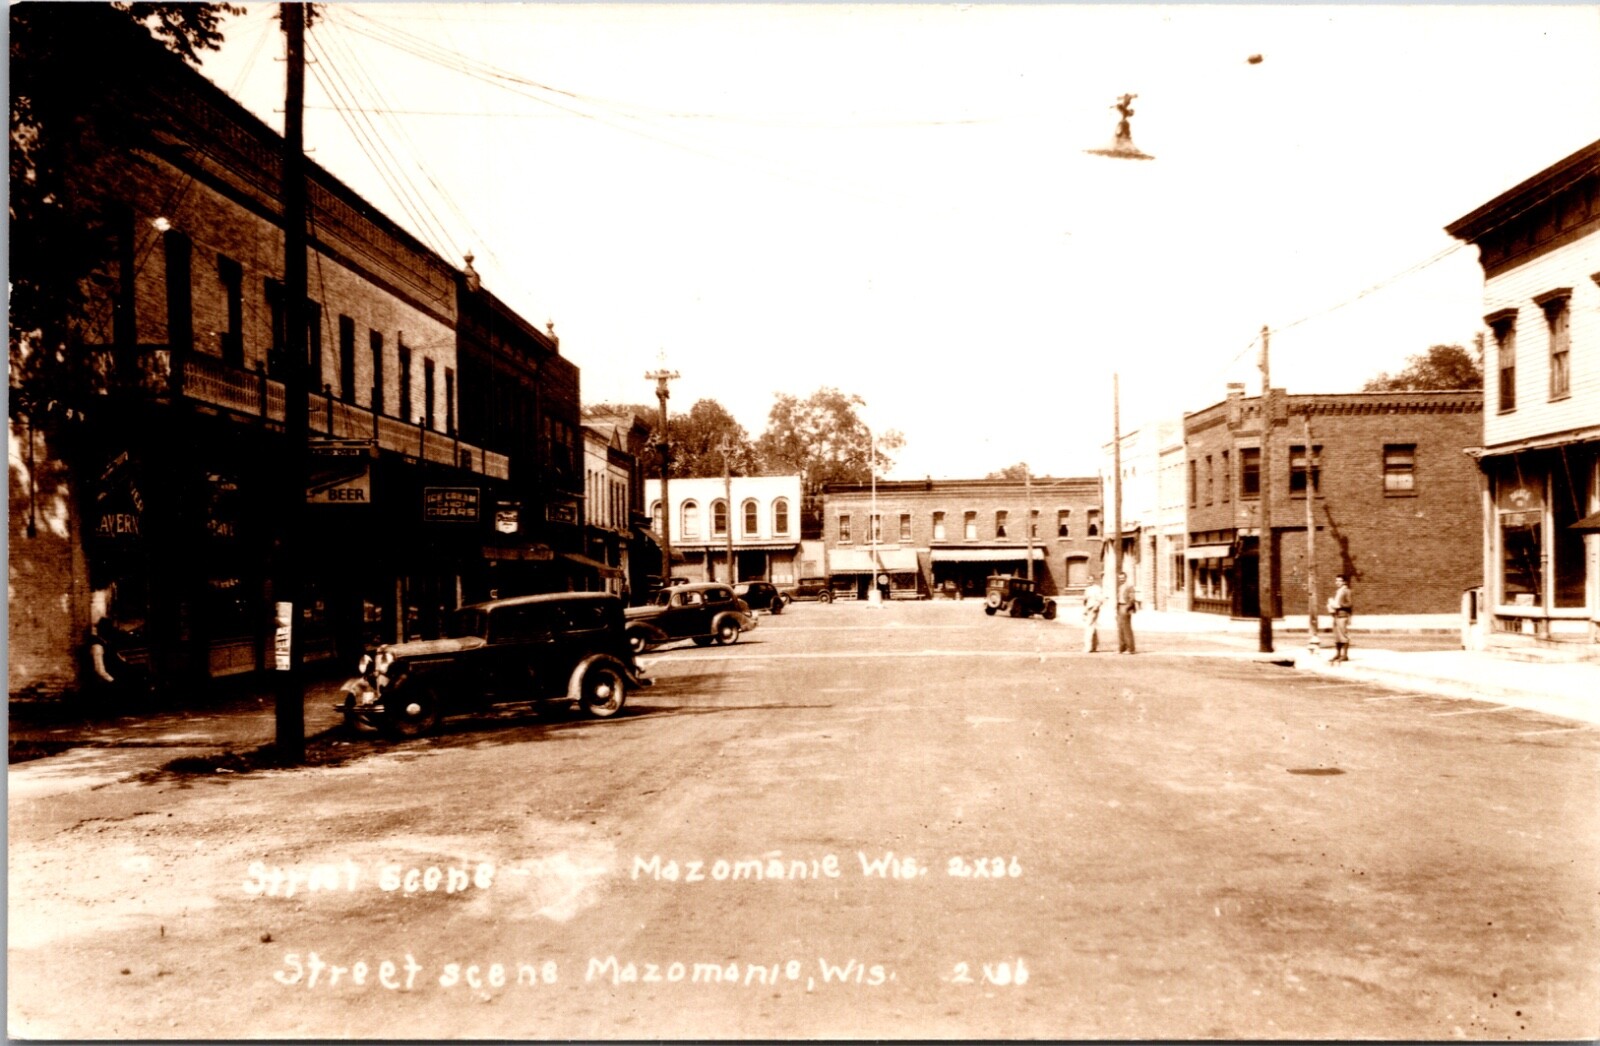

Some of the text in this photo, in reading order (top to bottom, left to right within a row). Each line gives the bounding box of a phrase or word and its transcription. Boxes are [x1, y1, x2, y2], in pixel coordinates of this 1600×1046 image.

[328, 488, 365, 501] BEER
[427, 491, 477, 503] ICE CREAM
[427, 507, 476, 516] CIGARS
[96, 513, 140, 537] AVERN
